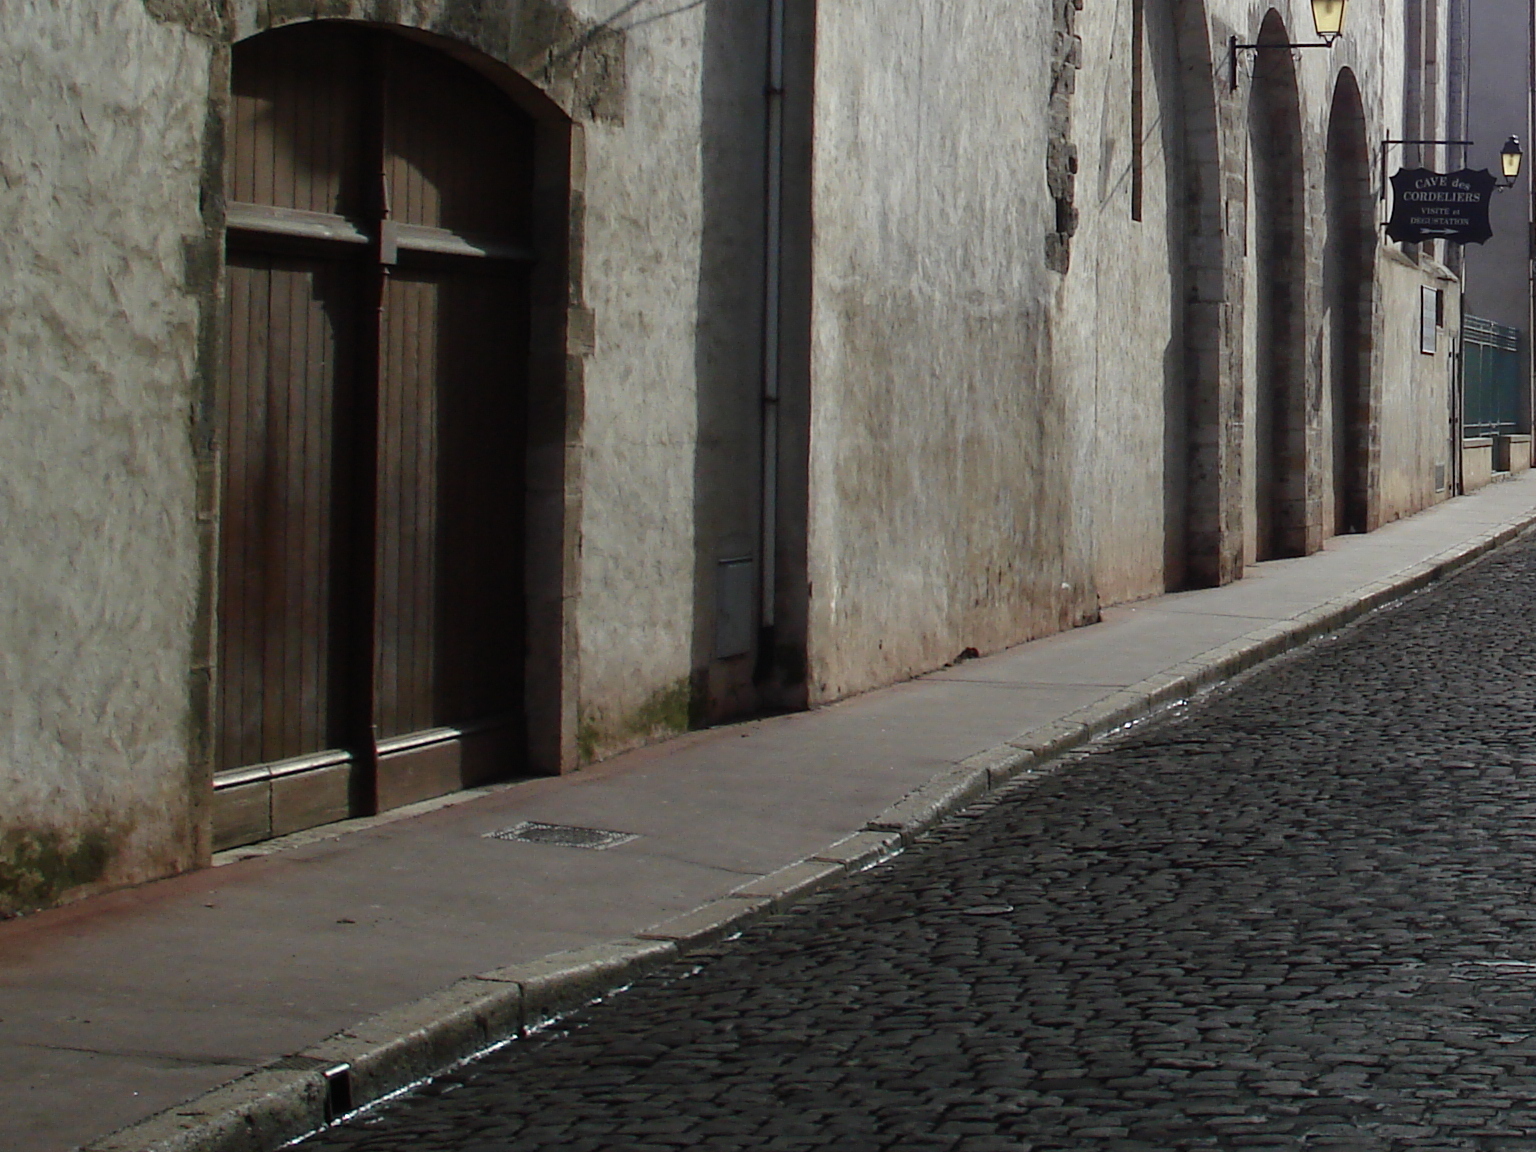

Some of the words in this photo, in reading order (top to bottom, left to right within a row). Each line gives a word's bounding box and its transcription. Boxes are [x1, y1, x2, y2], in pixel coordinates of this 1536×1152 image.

[1415, 176, 1448, 189] CAVE
[1451, 178, 1471, 190] des
[1403, 191, 1480, 202] CORDELIERS
[1421, 207, 1450, 215] VISITE
